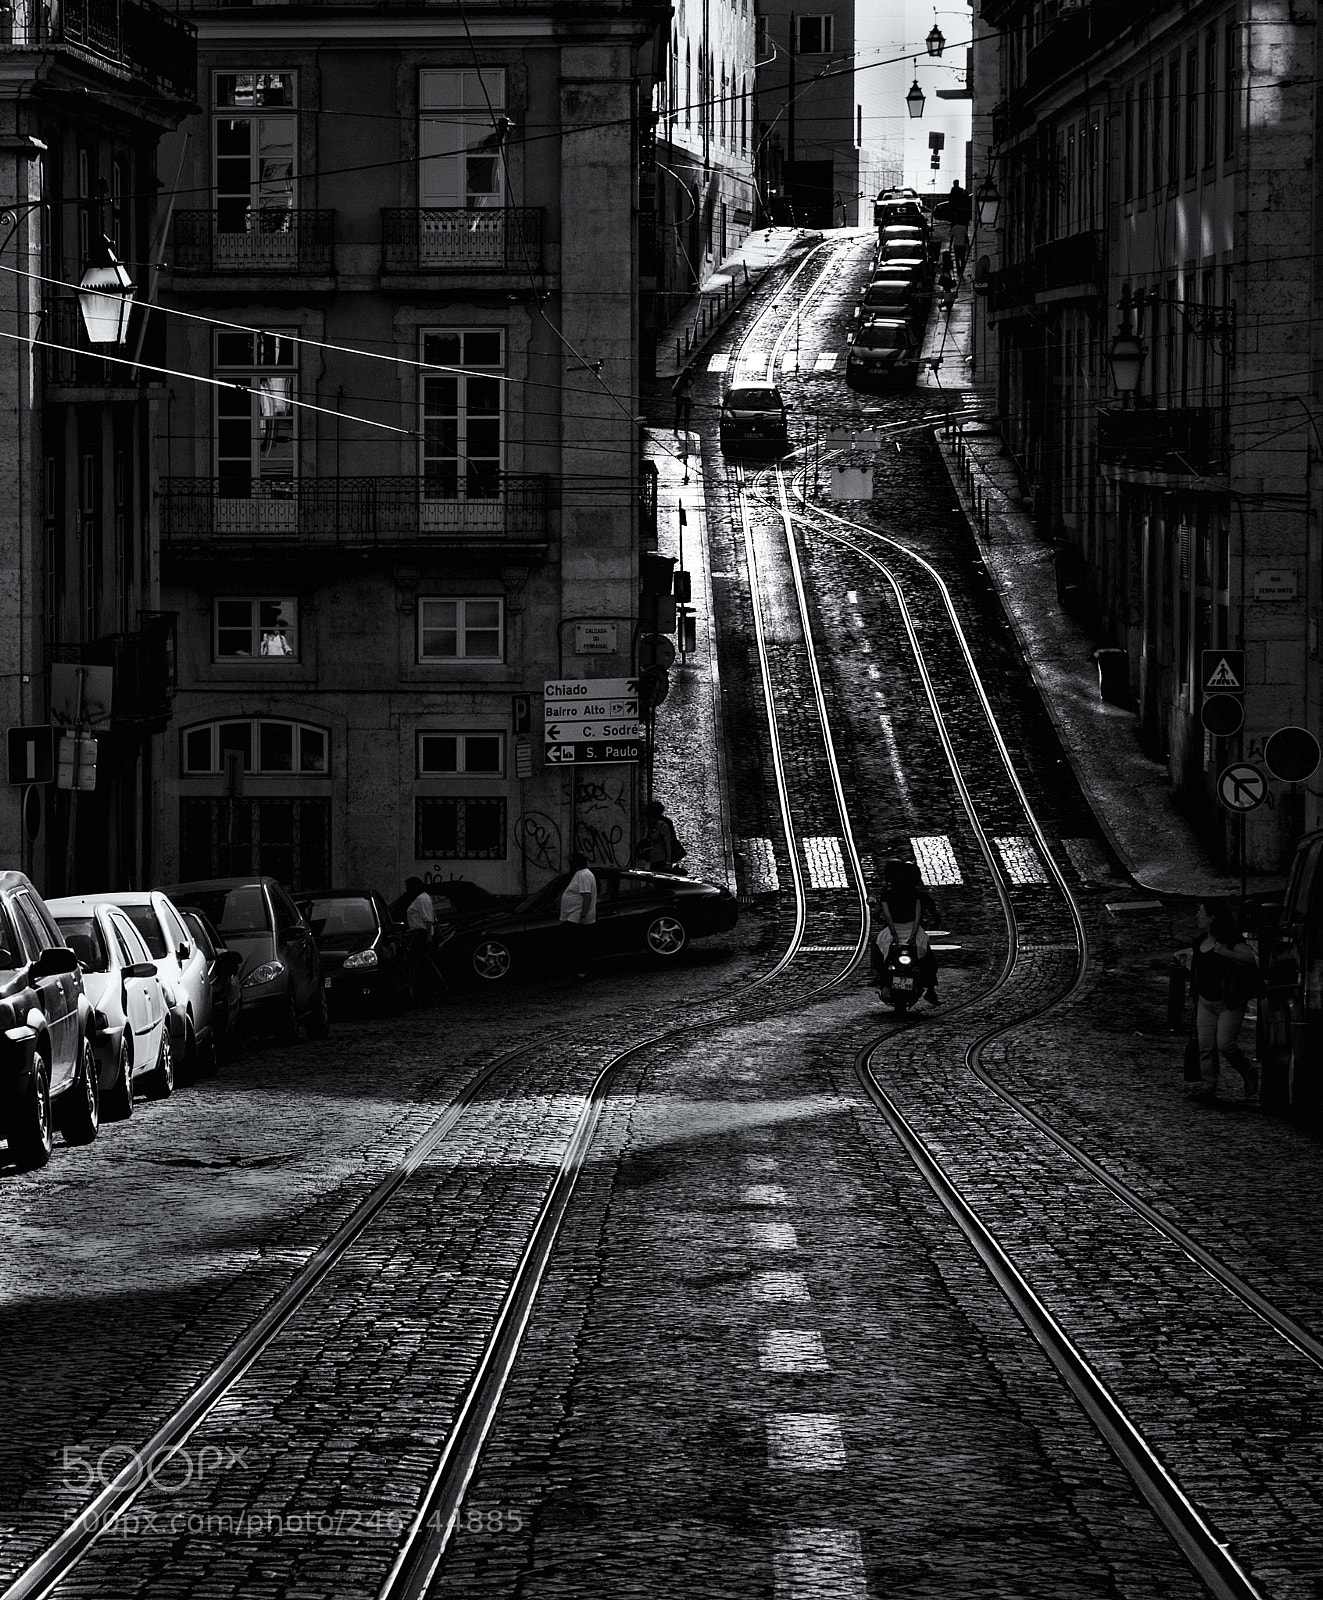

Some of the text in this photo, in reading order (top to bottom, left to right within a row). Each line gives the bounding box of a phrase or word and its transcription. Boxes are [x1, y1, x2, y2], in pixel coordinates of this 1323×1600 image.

[545, 684, 588, 696] Chiado
[515, 698, 527, 731] P
[545, 705, 606, 717] Bairro Alto
[582, 723, 638, 737] C. Sodré
[586, 745, 638, 759] S. Paulo
